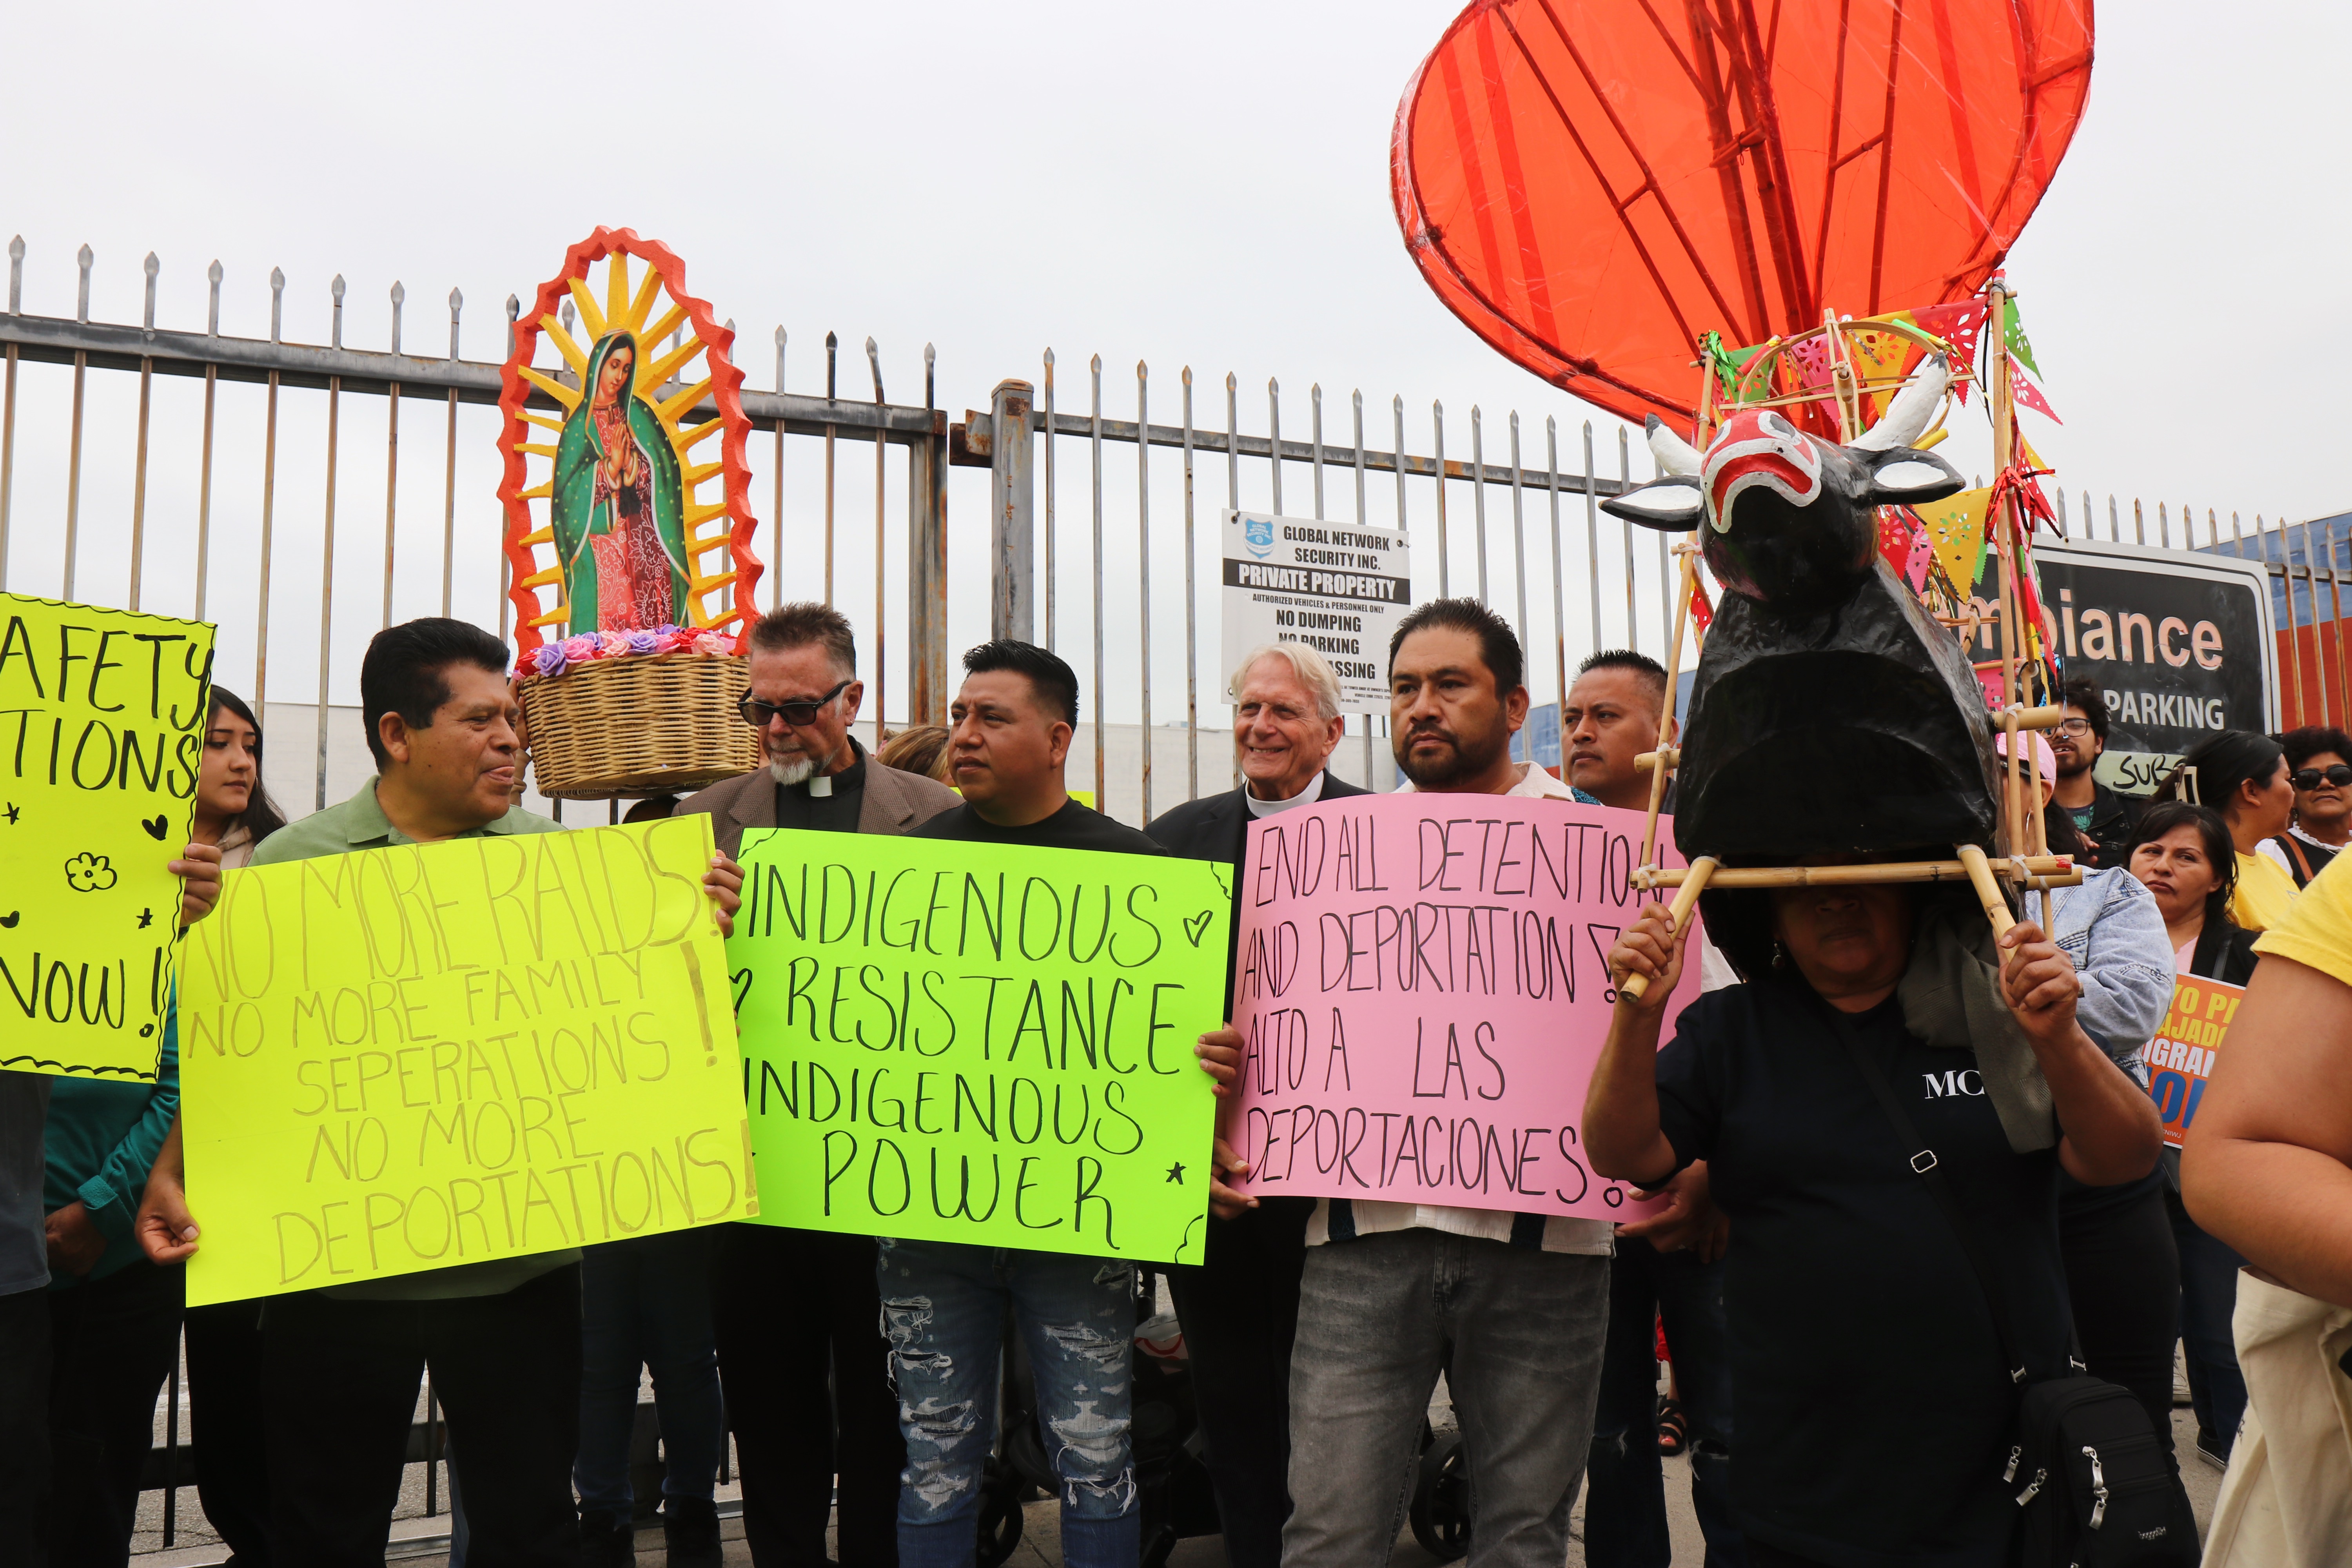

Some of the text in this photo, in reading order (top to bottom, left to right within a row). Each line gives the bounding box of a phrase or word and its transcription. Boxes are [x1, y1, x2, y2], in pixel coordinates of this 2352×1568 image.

[1238, 563, 1396, 600] PRIVATE PROPERTY
[1284, 526, 1390, 551] GLOBAL NETWORK
[1295, 548, 1381, 570] SECURITY INC.
[1253, 593, 1293, 605] AUTHORIZED
[1294, 598, 1324, 608] VEHICLES
[1332, 601, 1368, 612] PERSONNEL
[1370, 605, 1385, 614] ONLY
[1276, 609, 1361, 633] NO DUMPING
[1301, 635, 1359, 655] PARKING
[2103, 689, 2225, 731] PARKING
[1256, 815, 1325, 907] END
[1336, 814, 1388, 892] ALL
[179, 869, 274, 1009] NO
[300, 841, 480, 991] MORE
[748, 862, 1161, 967] INDIGENOUS
[187, 1002, 264, 1059] NO
[293, 975, 437, 1049] MORE
[465, 950, 645, 1026] FAMILY
[1240, 920, 1299, 1005] AND
[788, 956, 1185, 1075] RESISTANCE
[1240, 1007, 1505, 1101] ALTO A LAS
[292, 1011, 670, 1117] SEPERATIONS
[744, 1057, 1143, 1155] INDIGENOUS
[1922, 1069, 1985, 1099] MC
[305, 1089, 604, 1183] NO MORE
[271, 1118, 760, 1286] DEPORTATIONS!
[822, 1130, 1120, 1250] POWER
